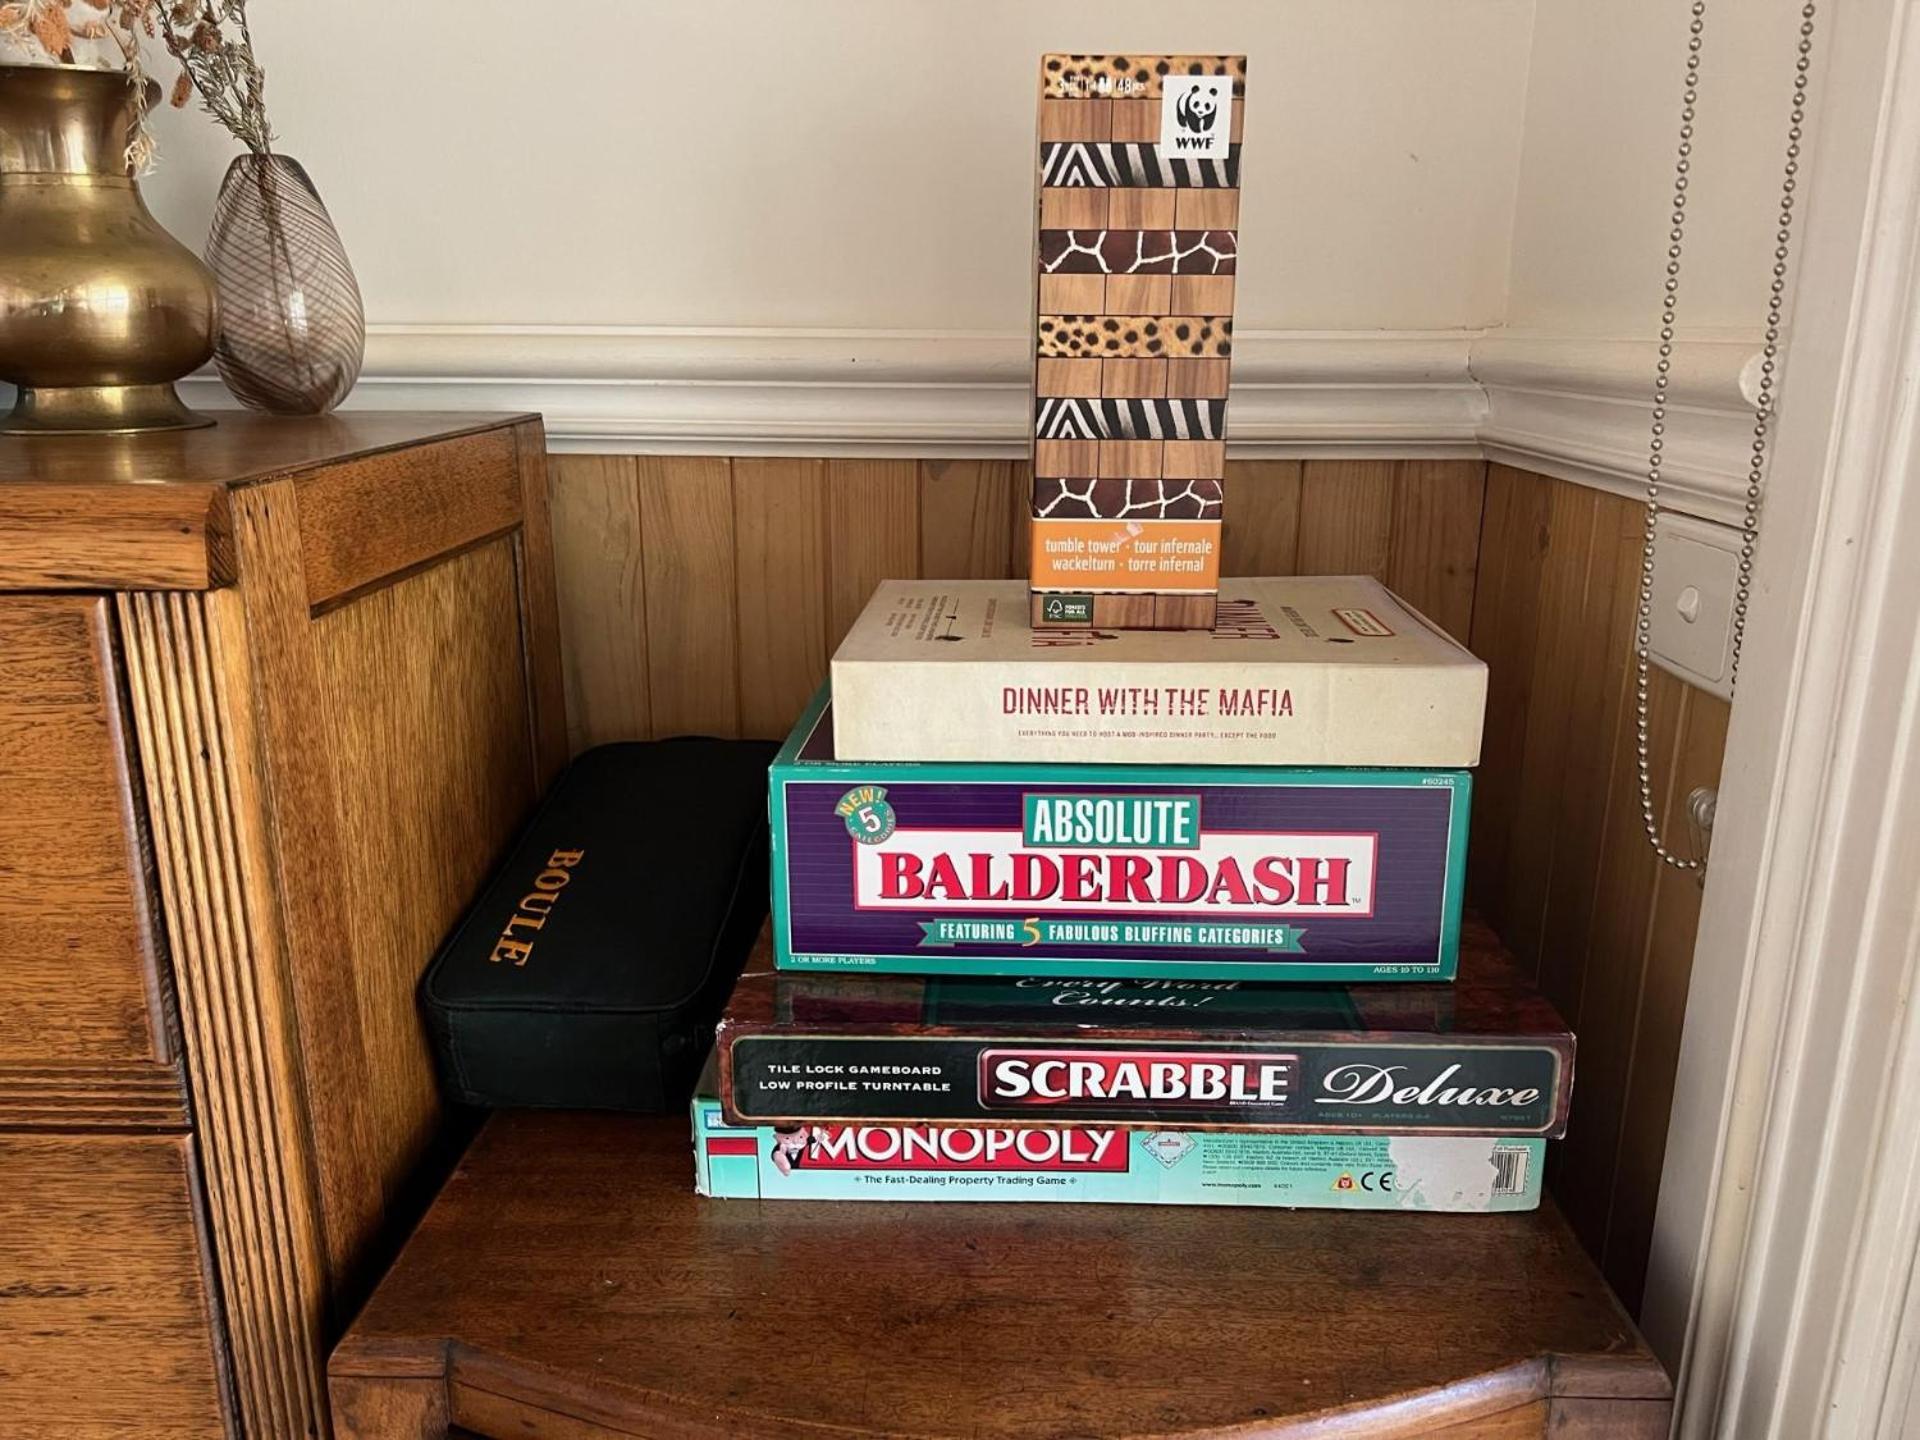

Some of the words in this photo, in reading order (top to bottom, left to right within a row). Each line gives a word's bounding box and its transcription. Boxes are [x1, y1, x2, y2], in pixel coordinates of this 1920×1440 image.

[1175, 137, 1215, 150] WWF
[1045, 538, 1084, 553] tumble
[1088, 540, 1121, 554] tower
[1134, 540, 1158, 554] tour
[1160, 538, 1212, 554] infernale
[1052, 556, 1115, 571] wackelturn
[1128, 557, 1156, 572] torre
[1159, 556, 1205, 572] infernal
[1002, 687, 1089, 715] DINNER
[1098, 688, 1158, 716] WITH
[1165, 688, 1211, 717] THE
[1218, 688, 1295, 717] MAFIA
[1018, 729, 1056, 737] EVERYTHING
[1058, 729, 1070, 737] YOU
[840, 787, 882, 816] NEW!
[858, 806, 882, 833] 5
[1033, 798, 1191, 845] ABSOLUTE
[877, 852, 1352, 906] BALDERDASH
[489, 849, 585, 966] BOULE
[940, 922, 1015, 940] FEATURING
[1021, 917, 1043, 947] 5
[1049, 924, 1119, 942] FABULOUS
[1125, 926, 1192, 944] BLUFFING
[1198, 927, 1284, 945] CATEGORIES
[838, 957, 876, 965] PLAYERS
[1373, 966, 1398, 974] AGES
[1015, 978, 1125, 994] Every
[1134, 978, 1240, 991] Word
[1051, 990, 1216, 1008] Counts!
[767, 1065, 801, 1074] TILE
[805, 1065, 844, 1074] LOCK
[849, 1066, 942, 1075] GAMEBOARD
[759, 1081, 791, 1090] LOW
[796, 1081, 858, 1091] PROFILE
[862, 1082, 951, 1092] TURNTABLE
[994, 1059, 1289, 1102] SCRABBLE
[1314, 1063, 1540, 1107] Deluxe
[811, 1127, 1116, 1163] MONOPOLY
[864, 1174, 882, 1184] The
[885, 1174, 945, 1186] Fast-Dealing
[948, 1175, 994, 1187] Property
[997, 1175, 1034, 1187] Trading
[1036, 1176, 1067, 1186] Game
